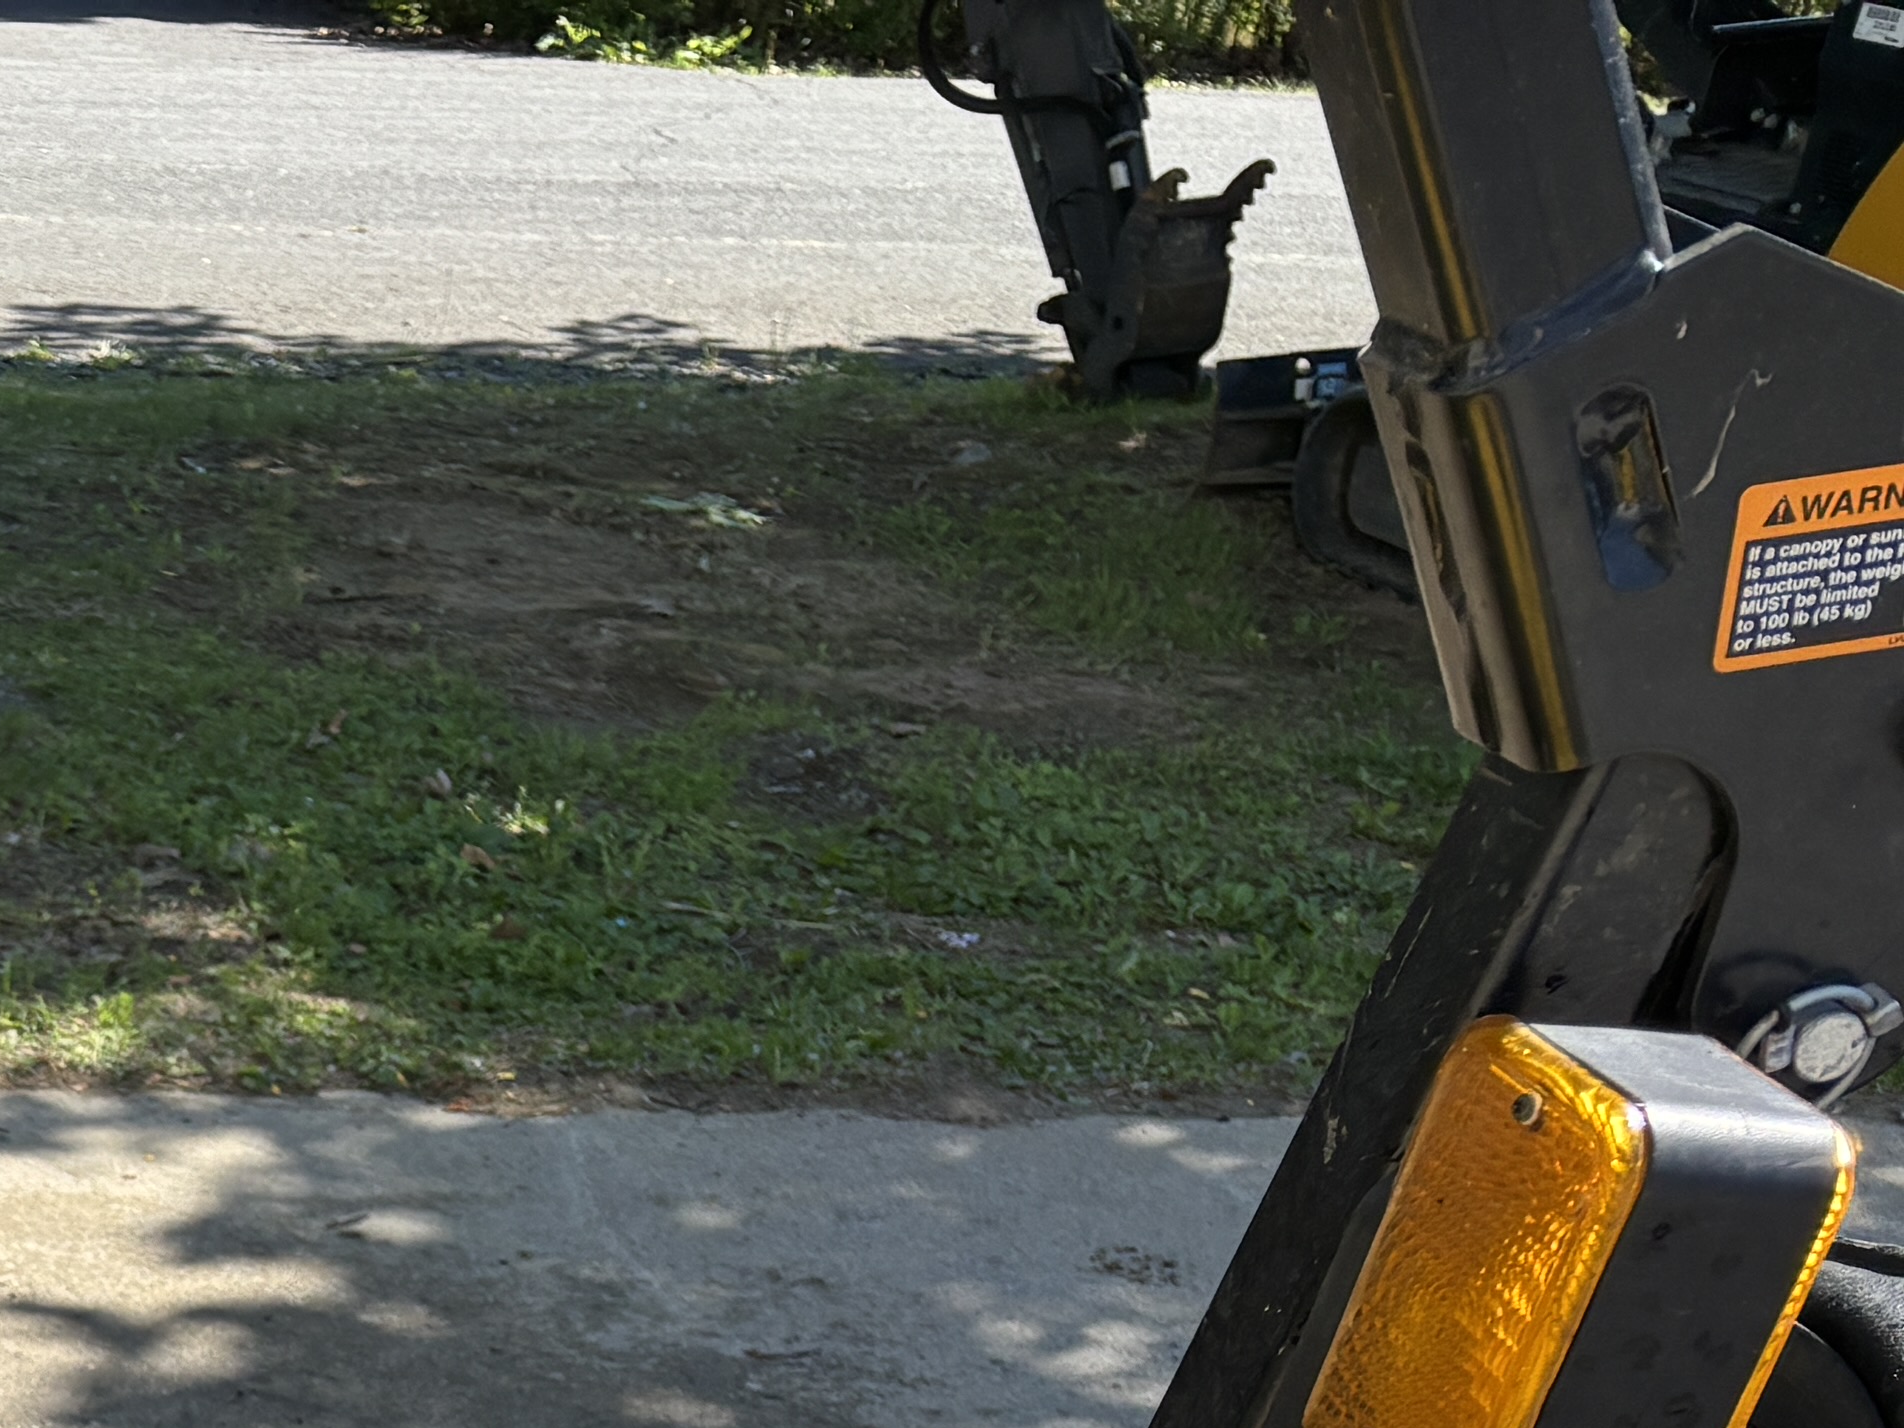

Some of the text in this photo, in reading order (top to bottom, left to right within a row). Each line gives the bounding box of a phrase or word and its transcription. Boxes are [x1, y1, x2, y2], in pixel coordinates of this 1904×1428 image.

[1801, 482, 1904, 521] WARN
[1748, 528, 1904, 562] If a canopy or sun
[1745, 564, 1761, 580] is
[1765, 553, 1841, 578] attached
[1844, 552, 1862, 566] to
[1865, 546, 1894, 564] the
[1740, 581, 1881, 616] MUST be limited
[1742, 575, 1825, 598] structure,
[1829, 569, 1857, 586] the
[1736, 600, 1873, 635] to 100 lb (45 kg)
[1733, 631, 1796, 652] or less.
